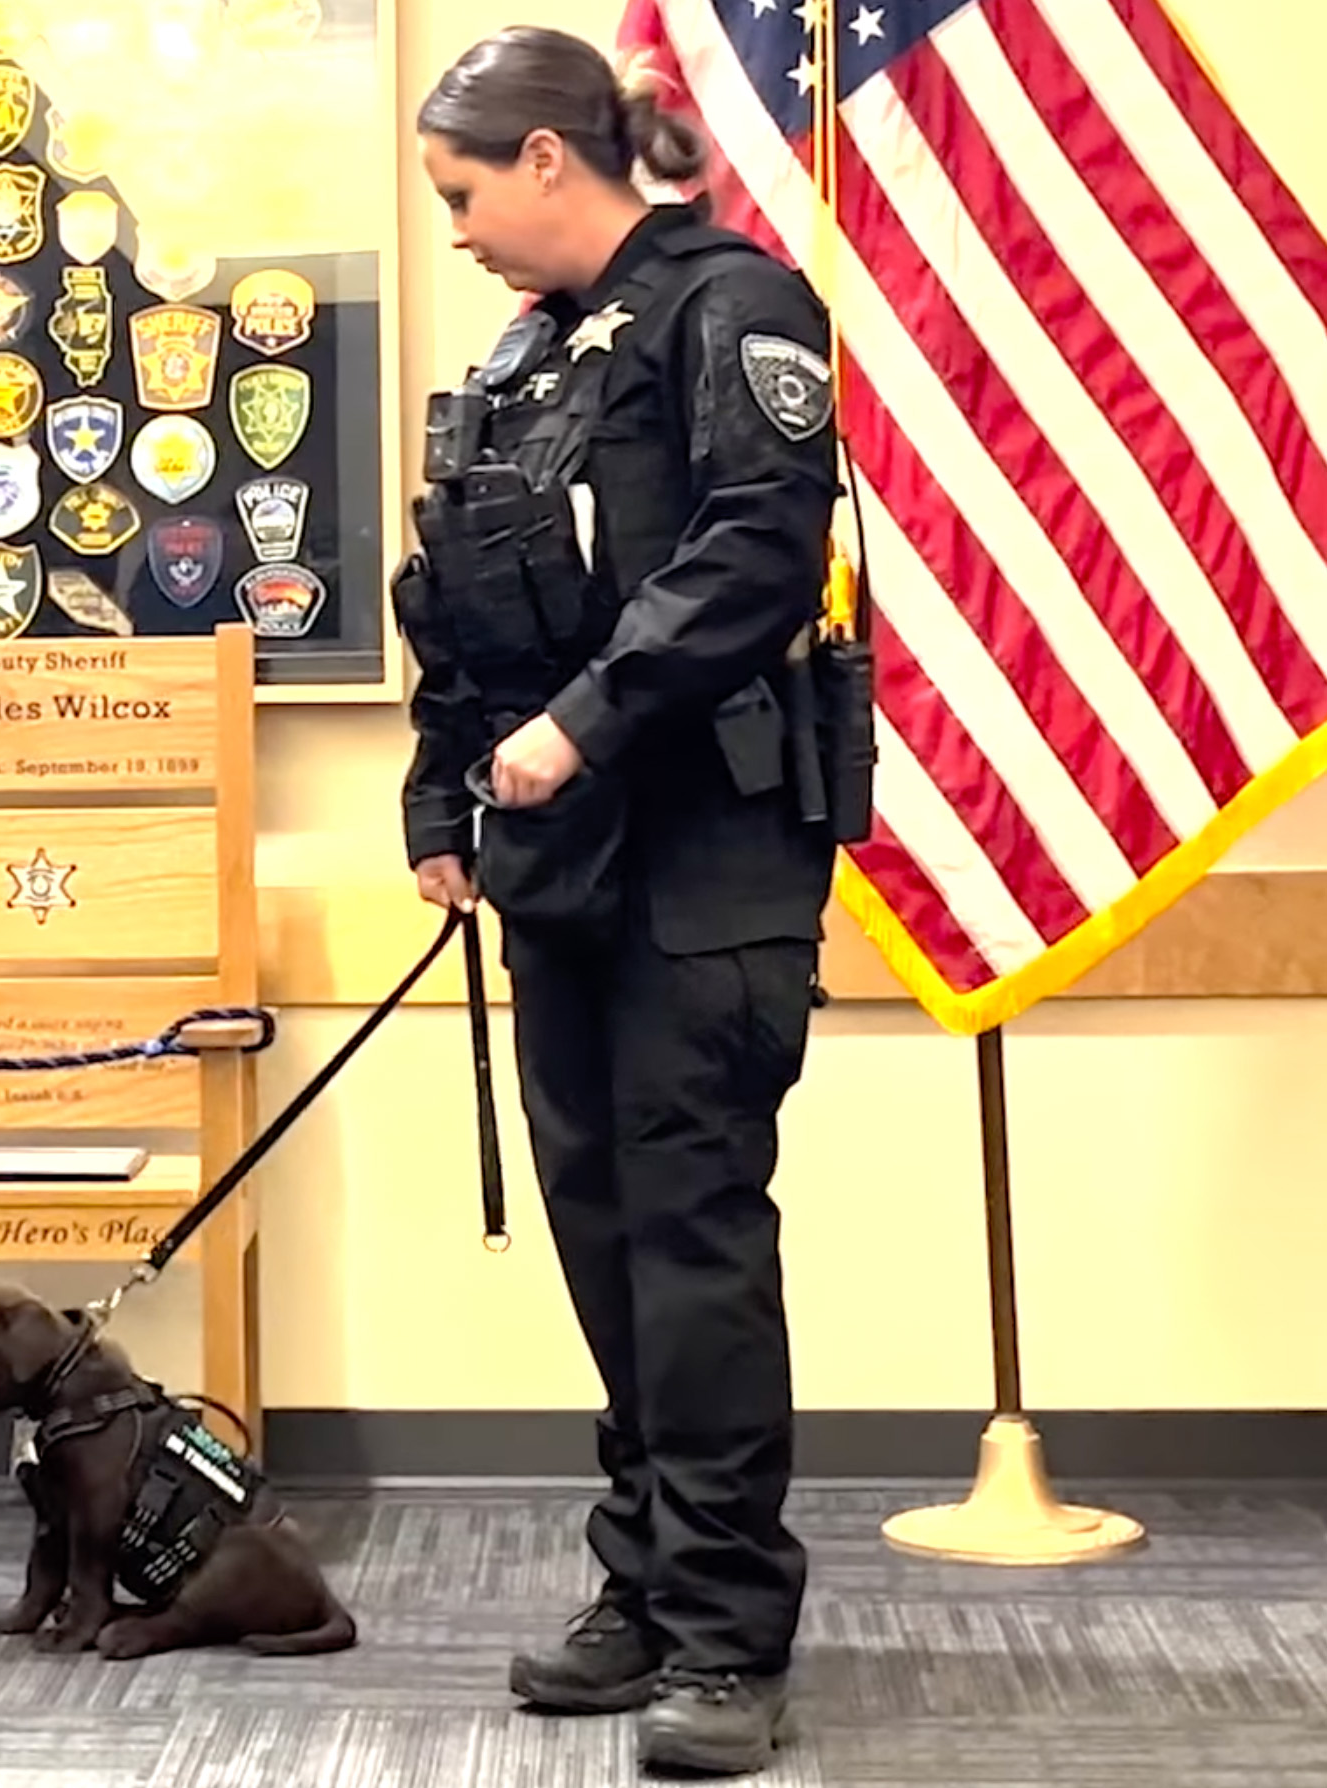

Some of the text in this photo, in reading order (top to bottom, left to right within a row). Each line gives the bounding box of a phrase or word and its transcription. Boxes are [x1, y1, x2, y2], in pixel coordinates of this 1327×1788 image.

[135, 312, 216, 338] SHERIFF
[245, 316, 301, 337] POLICE
[243, 484, 301, 508] POLICE
[44, 651, 128, 671] Sheriff
[53, 694, 173, 720] Wilcox
[15, 758, 119, 776] September
[98, 1215, 169, 1246] Plac
